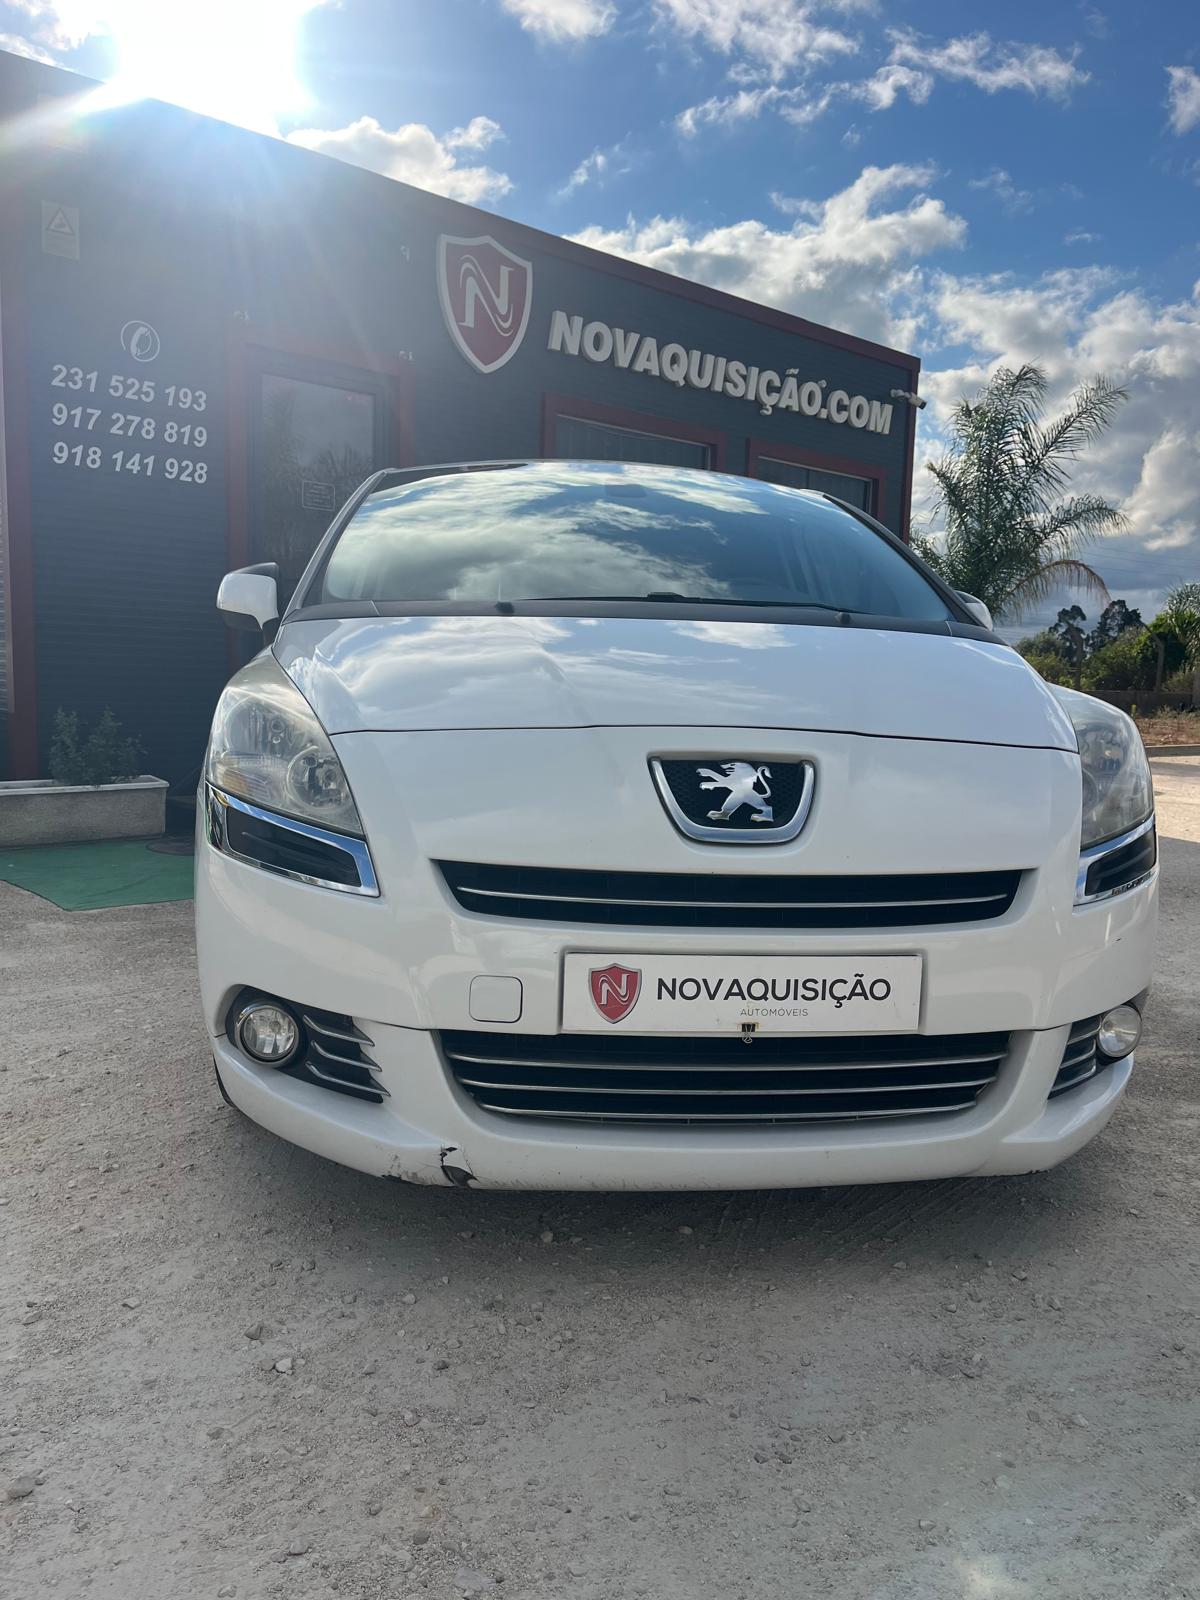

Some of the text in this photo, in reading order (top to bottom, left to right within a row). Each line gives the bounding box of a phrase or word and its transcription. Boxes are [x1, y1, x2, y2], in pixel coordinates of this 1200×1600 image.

[51, 364, 207, 412] 231 525 193
[547, 309, 894, 435] NOVAQUISIÇÃO.COM
[52, 403, 207, 447] 917 278 819
[53, 441, 208, 484] 918 141 928
[657, 973, 892, 1008] NOVAQUISIÇÃO
